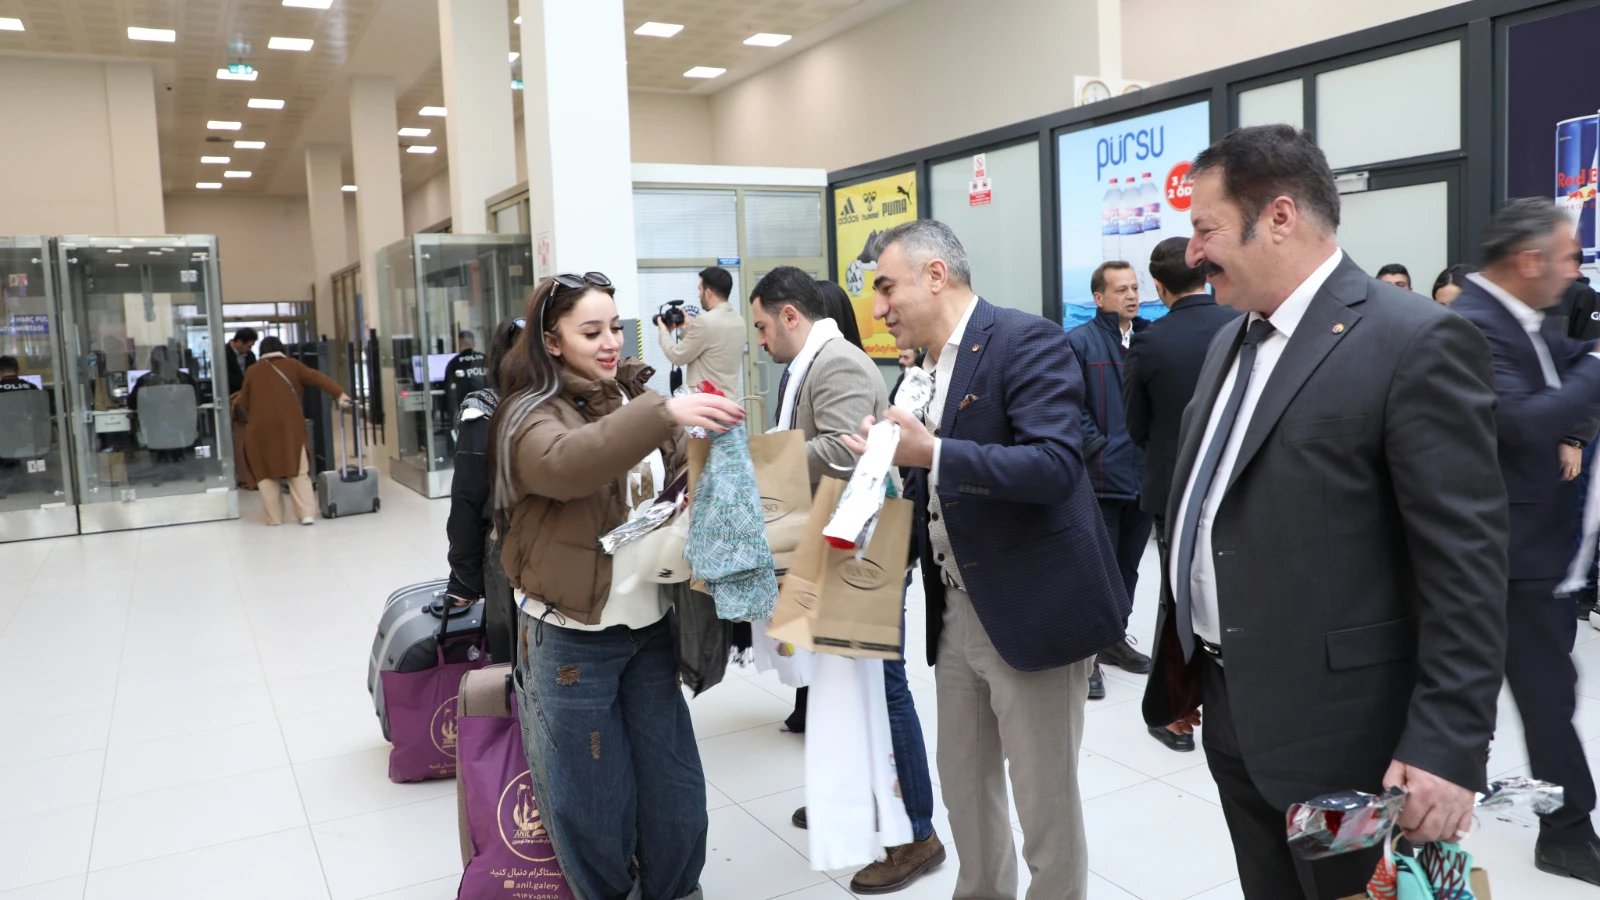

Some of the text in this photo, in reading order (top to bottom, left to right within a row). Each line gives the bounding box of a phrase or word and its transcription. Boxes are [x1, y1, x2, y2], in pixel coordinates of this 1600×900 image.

[1171, 176, 1179, 187] 3
[1557, 168, 1586, 188] Red
[1167, 188, 1175, 199] 2
[882, 199, 907, 217] PUMA
[838, 214, 859, 225] adidas
[490, 868, 563, 878] ینستاگرام دنبال کنید
[515, 880, 560, 891] anil.galery
